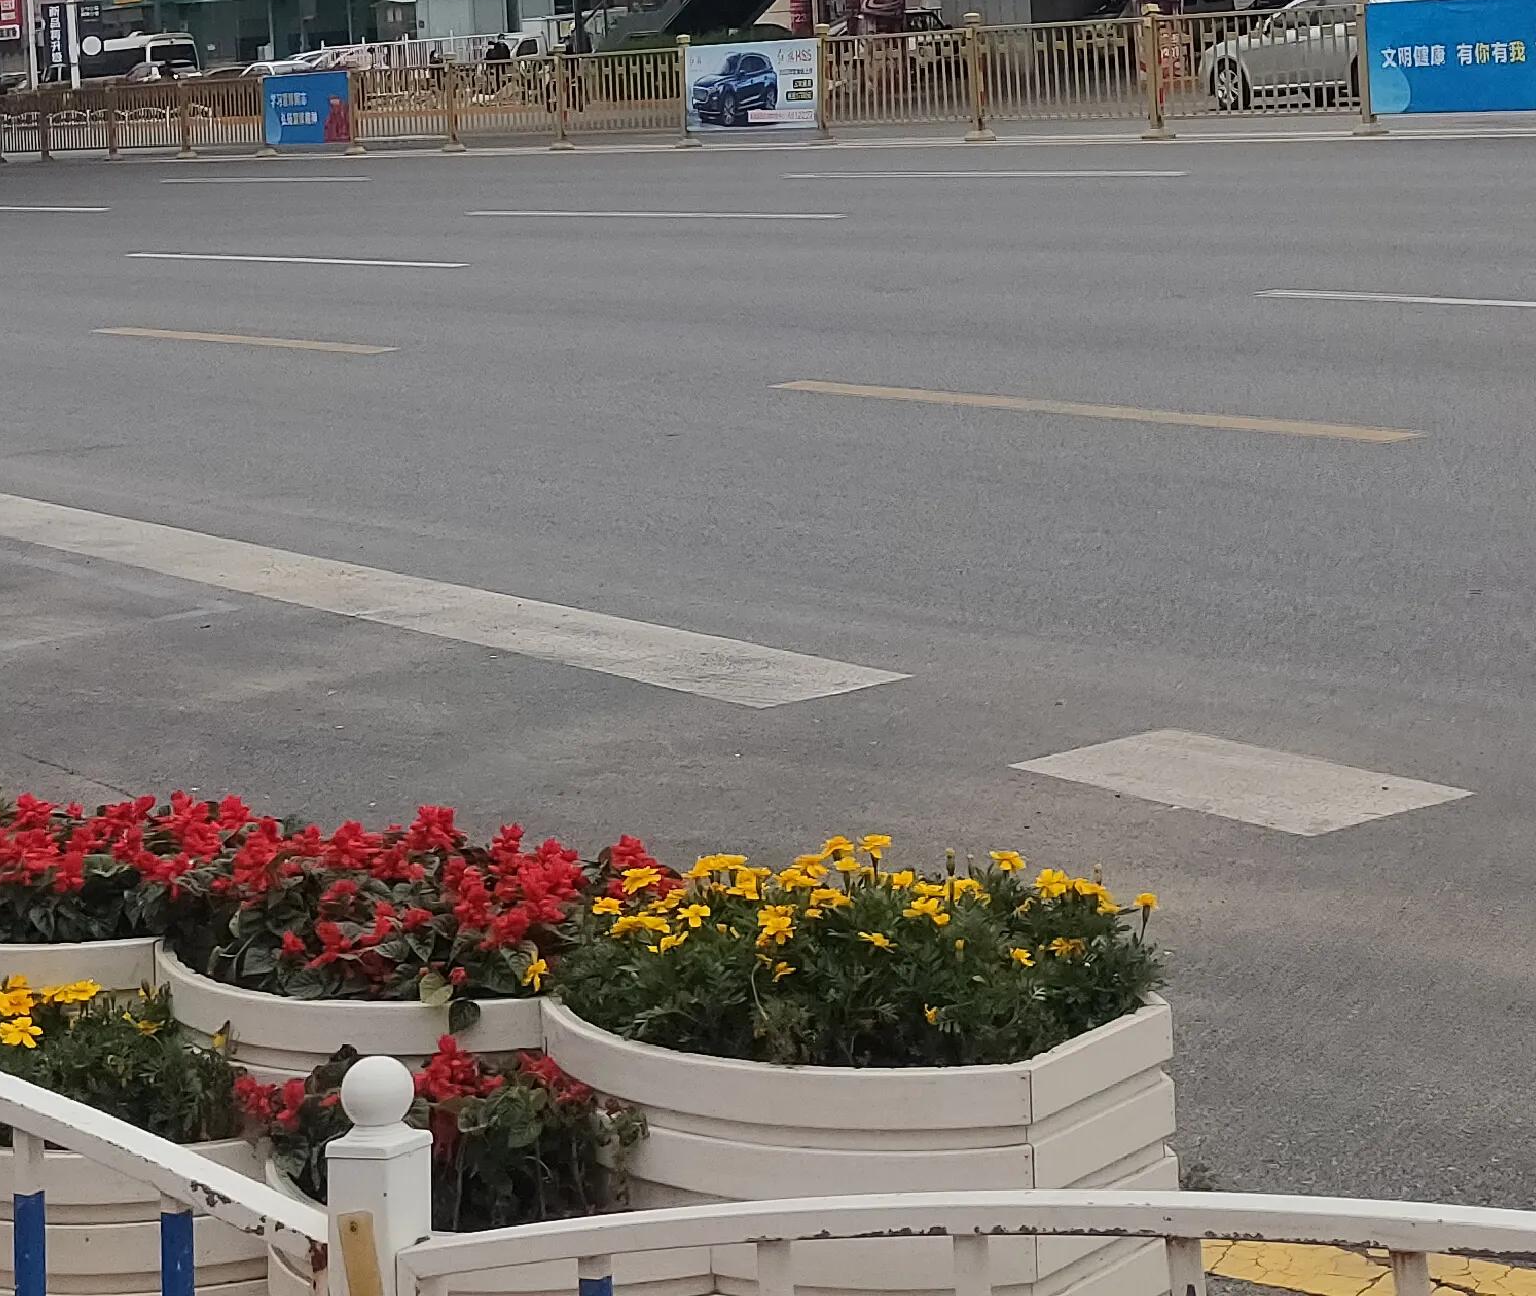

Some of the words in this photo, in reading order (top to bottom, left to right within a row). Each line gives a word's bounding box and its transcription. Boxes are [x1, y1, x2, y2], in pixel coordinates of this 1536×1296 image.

[1380, 45, 1446, 71] 文明健康
[1457, 40, 1527, 66] 有你有我
